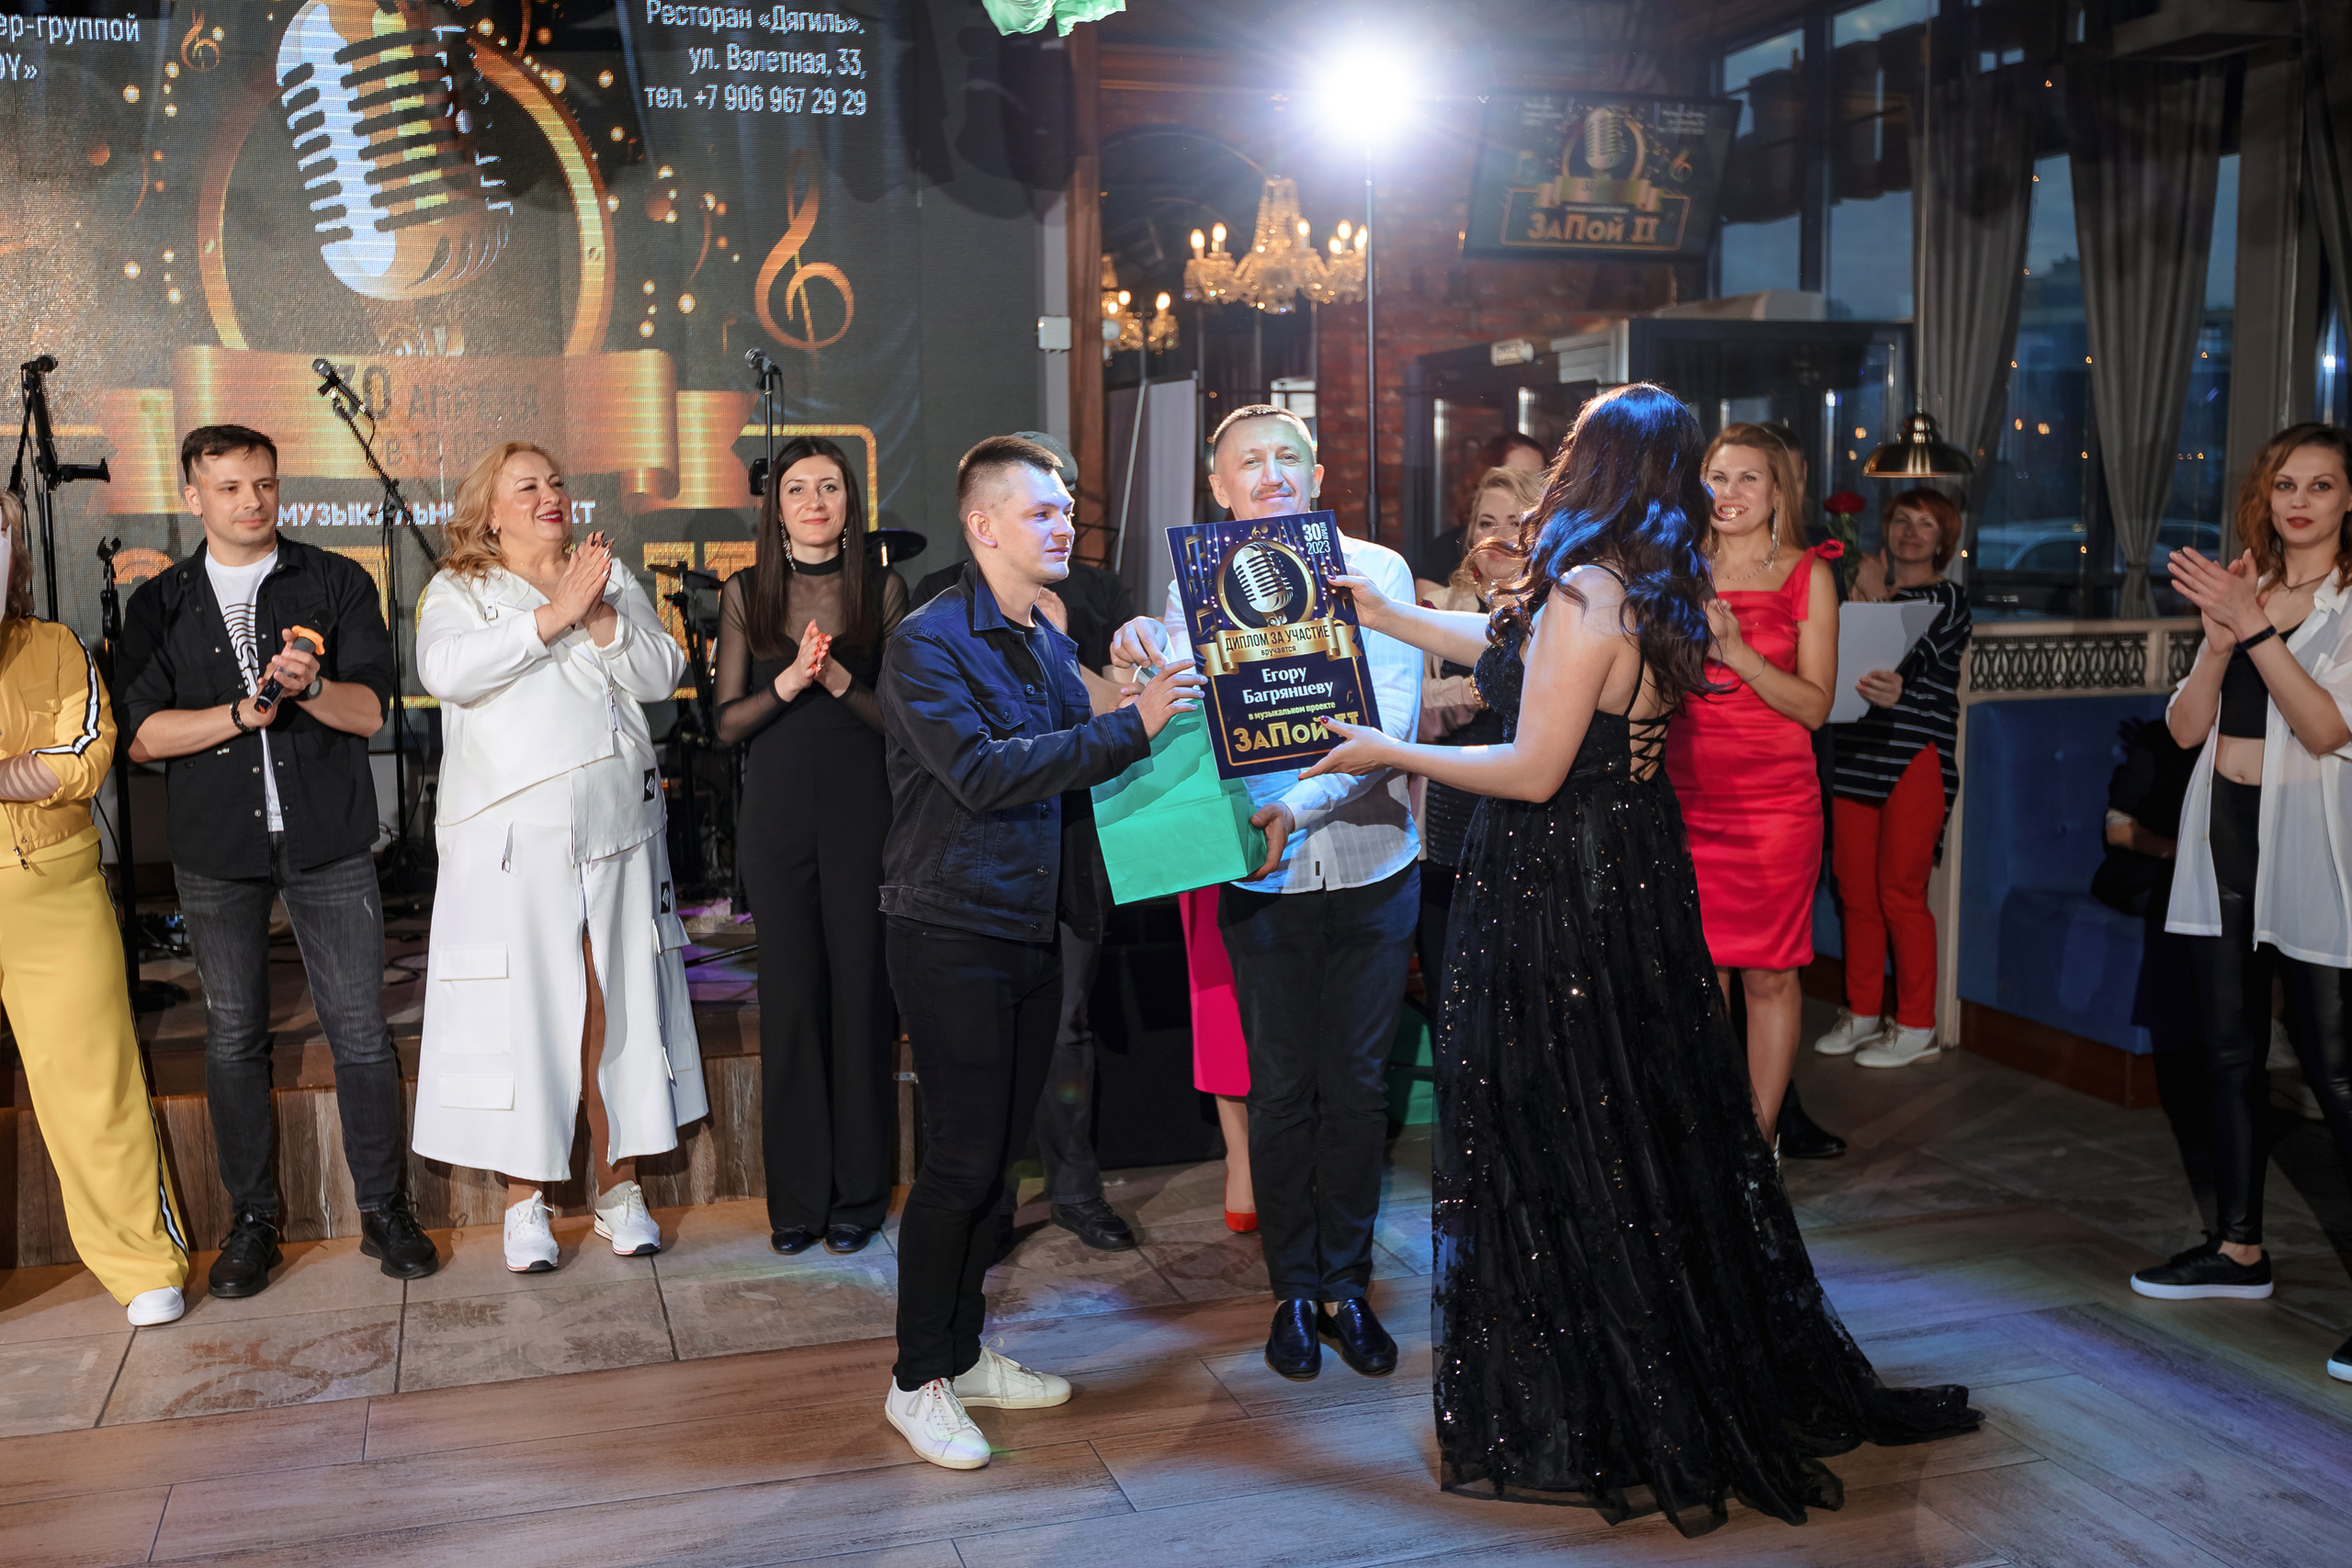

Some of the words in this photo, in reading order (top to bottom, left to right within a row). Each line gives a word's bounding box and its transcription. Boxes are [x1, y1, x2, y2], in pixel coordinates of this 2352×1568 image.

[647, 0, 752, 34] Ресторан
[689, 47, 720, 74] ул.
[727, 42, 832, 77] Взлетная,
[837, 48, 866, 79] 33,
[644, 85, 688, 108] тел.
[694, 84, 718, 109] +7
[724, 84, 763, 111] 906
[769, 85, 806, 113] 967
[810, 87, 836, 114] 29
[842, 88, 867, 116] 29
[1302, 523, 1322, 542] 30
[1306, 539, 1331, 555] 2023
[1225, 633, 1269, 651] ДИПЛОМ
[1270, 631, 1284, 645] ЗА
[1284, 625, 1330, 642] УЧАСТИЕ
[1261, 645, 1297, 657] вручается
[1261, 667, 1306, 683] Егору
[1242, 681, 1333, 705] Багрянцеву
[1254, 706, 1306, 720] музыкальном
[1306, 701, 1336, 713] проекте
